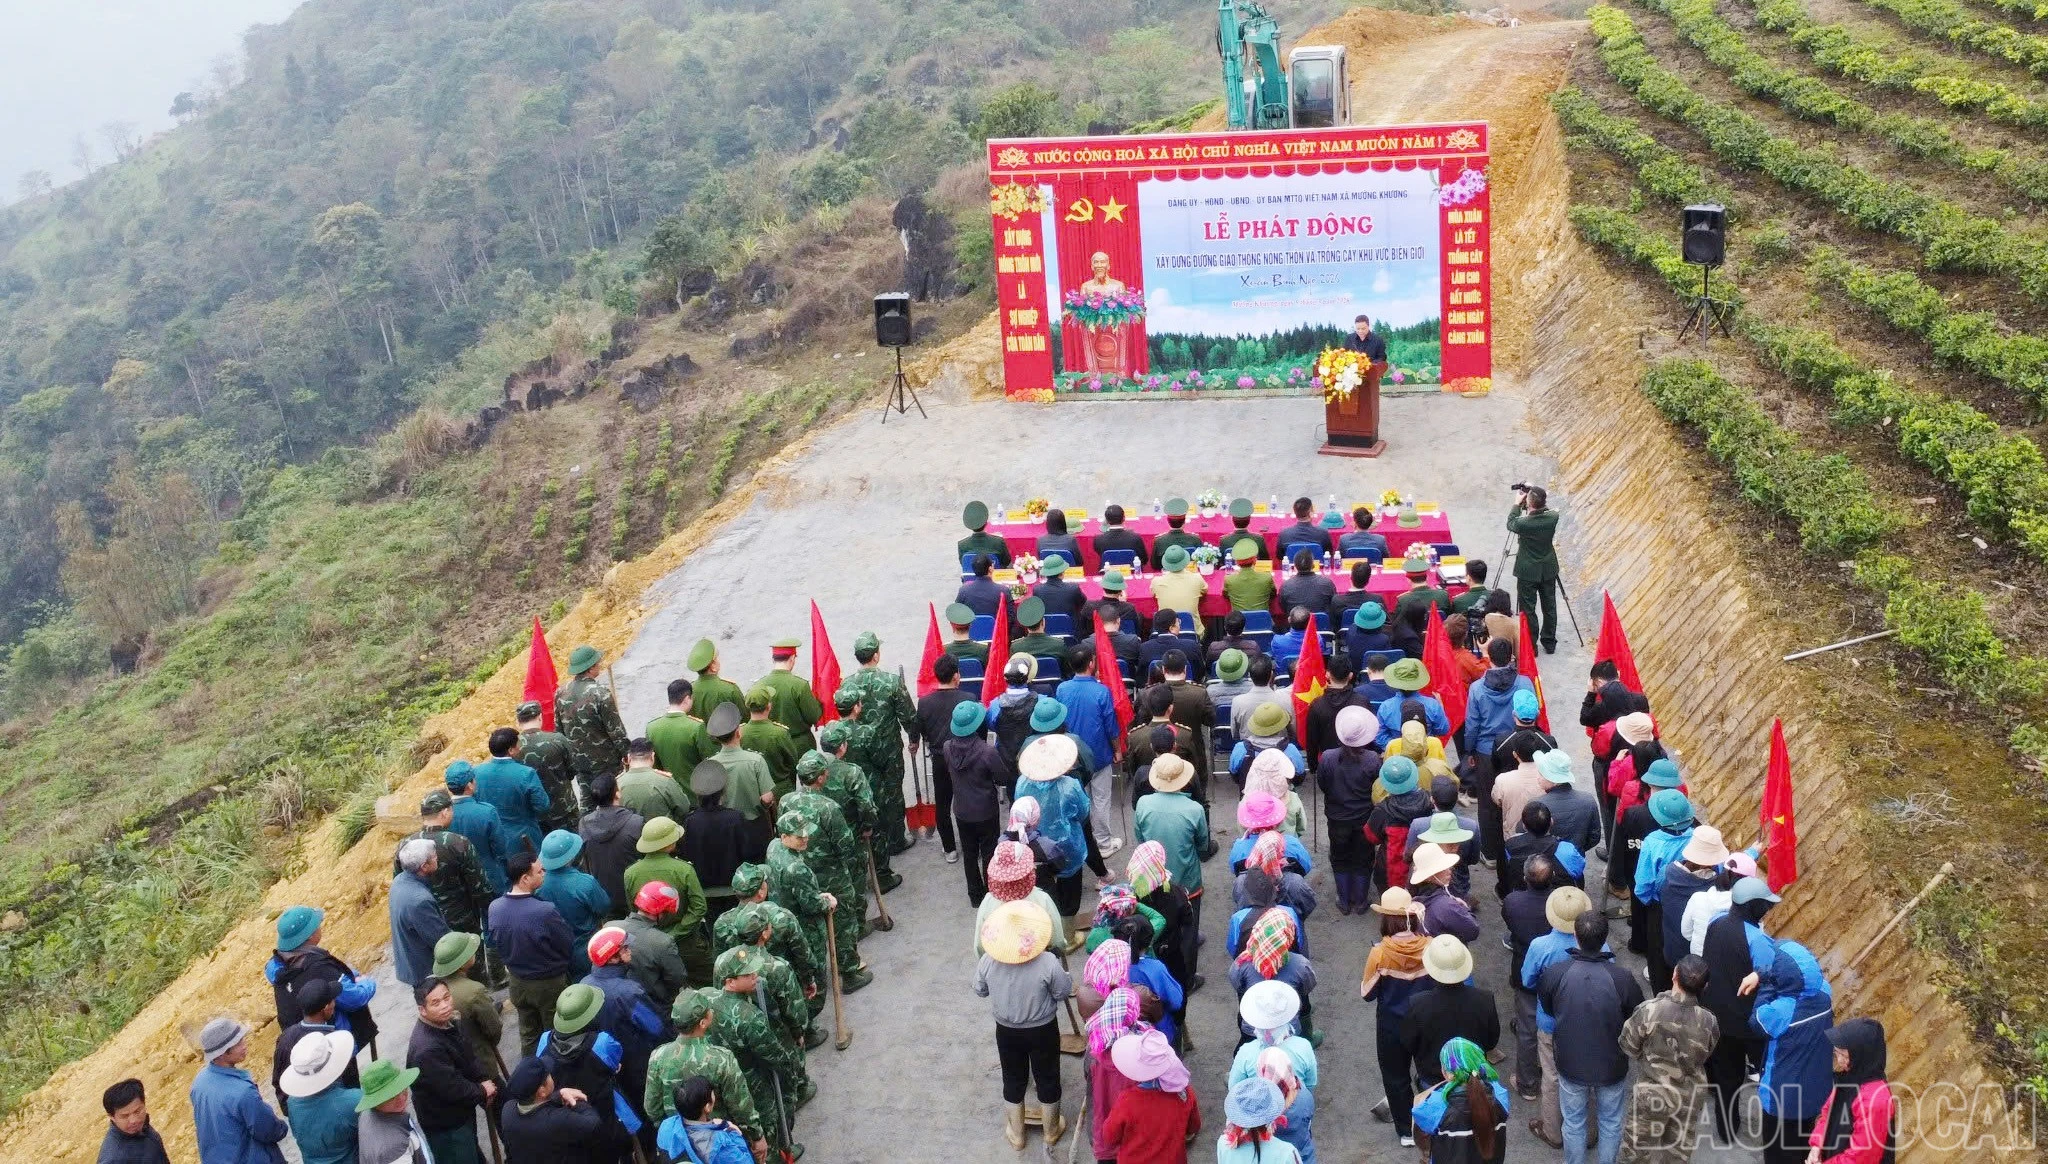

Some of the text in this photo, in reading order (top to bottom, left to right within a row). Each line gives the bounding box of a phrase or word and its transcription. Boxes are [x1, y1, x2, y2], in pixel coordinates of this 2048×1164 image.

[1034, 148, 1071, 164] NƯỚC
[1074, 147, 1112, 165] CỘNG
[1116, 146, 1145, 162] HOÀ
[1148, 144, 1169, 160] XÃ
[1172, 144, 1198, 161] HỘI
[1202, 140, 1229, 158] CHỦ
[1234, 141, 1280, 157] NGHĨA
[1283, 139, 1316, 157] VIỆT
[1319, 139, 1353, 154] NAM
[1356, 136, 1398, 152] MUÔN
[1402, 134, 1436, 150] NĂM
[1267, 195, 1282, 204] BAN
[1322, 192, 1338, 202] NAM
[1203, 212, 1374, 241] LỄ PHÁT ĐỘNG
[1156, 254, 1170, 268] XÂY
[1220, 253, 1236, 267] GIAO
[1237, 250, 1262, 266] THÔNG
[1263, 250, 1284, 266] NÔNG
[1358, 248, 1374, 261] KHU
